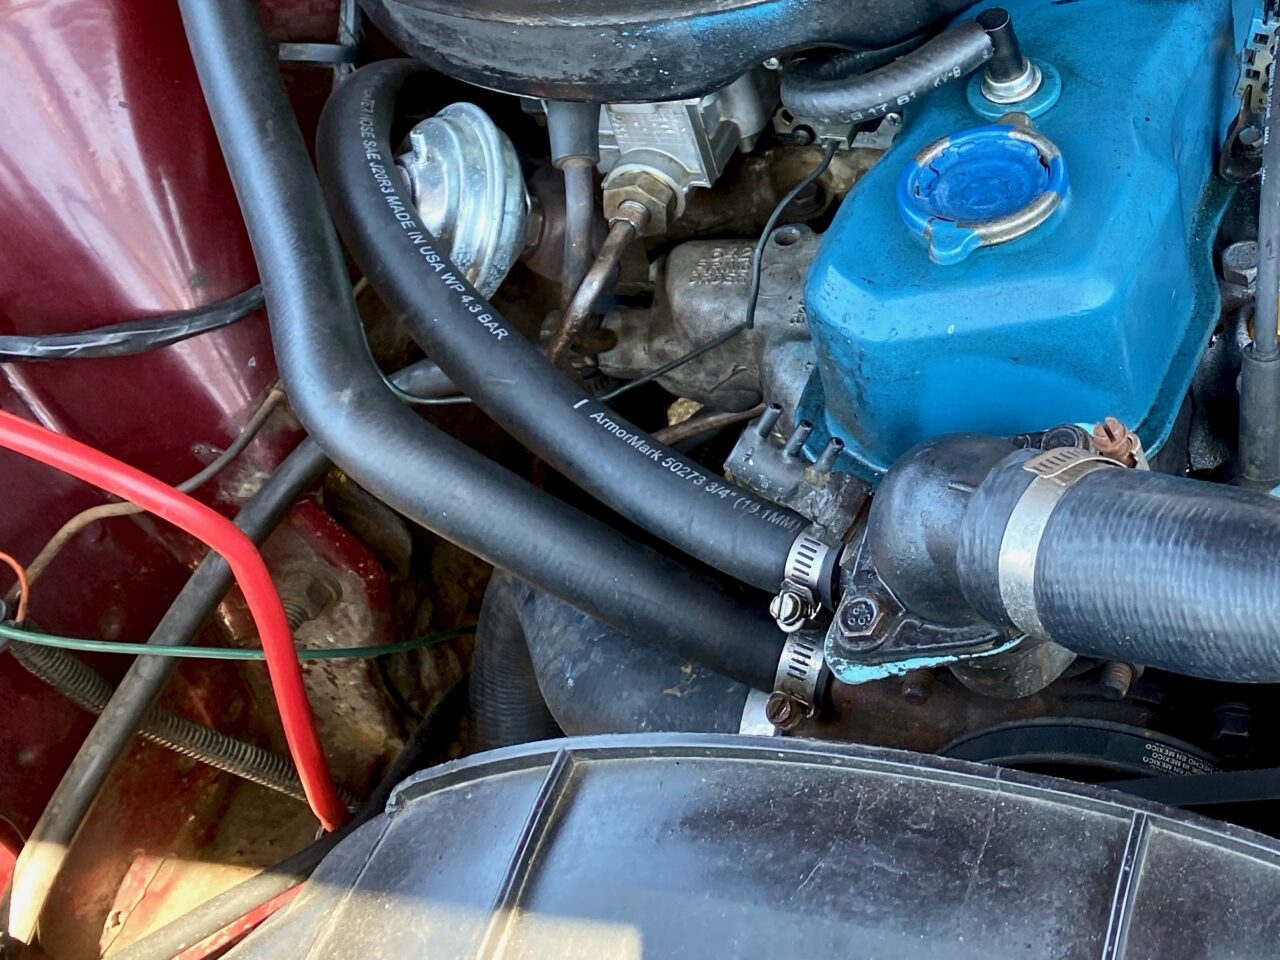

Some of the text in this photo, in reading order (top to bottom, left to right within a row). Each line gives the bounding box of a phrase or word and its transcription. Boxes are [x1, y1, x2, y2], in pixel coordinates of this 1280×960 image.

[363, 139, 382, 161] SAE
[369, 161, 395, 193] J20R3
[385, 194, 416, 230] MADE
[408, 231, 427, 244] IN
[419, 246, 446, 273] USA
[440, 272, 465, 292] WP
[461, 294, 482, 313] 4.3
[477, 313, 509, 340] BAR
[590, 411, 663, 461] ArmorMark
[661, 457, 706, 485] 50273
[1145, 743, 1176, 758] MEXICO
[1151, 752, 1181, 766] MEXICO
[1176, 753, 1187, 762] EN
[1142, 756, 1173, 770] MEXICO
